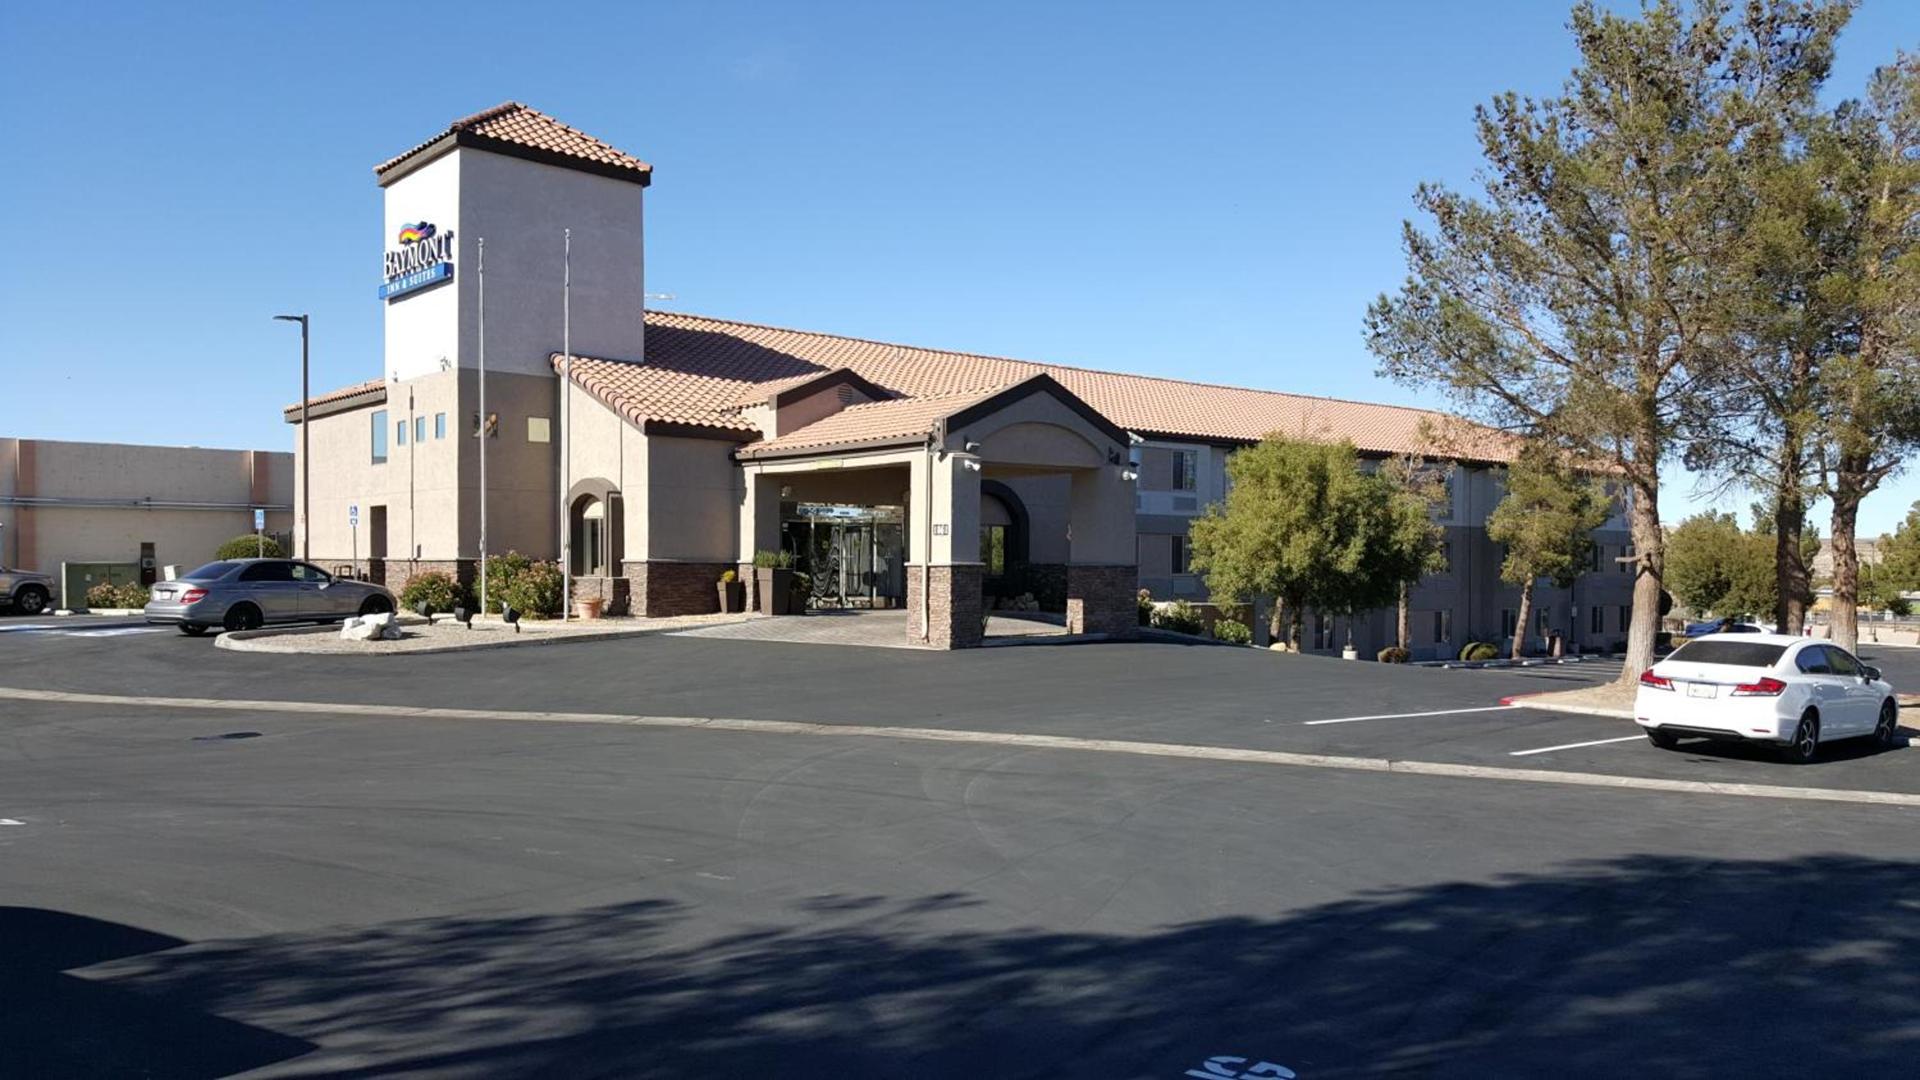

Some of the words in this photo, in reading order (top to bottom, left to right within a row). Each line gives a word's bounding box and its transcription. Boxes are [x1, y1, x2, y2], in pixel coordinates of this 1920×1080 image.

[384, 230, 454, 280] BAYMONT
[386, 281, 401, 294] INN
[409, 268, 437, 286] SUITES
